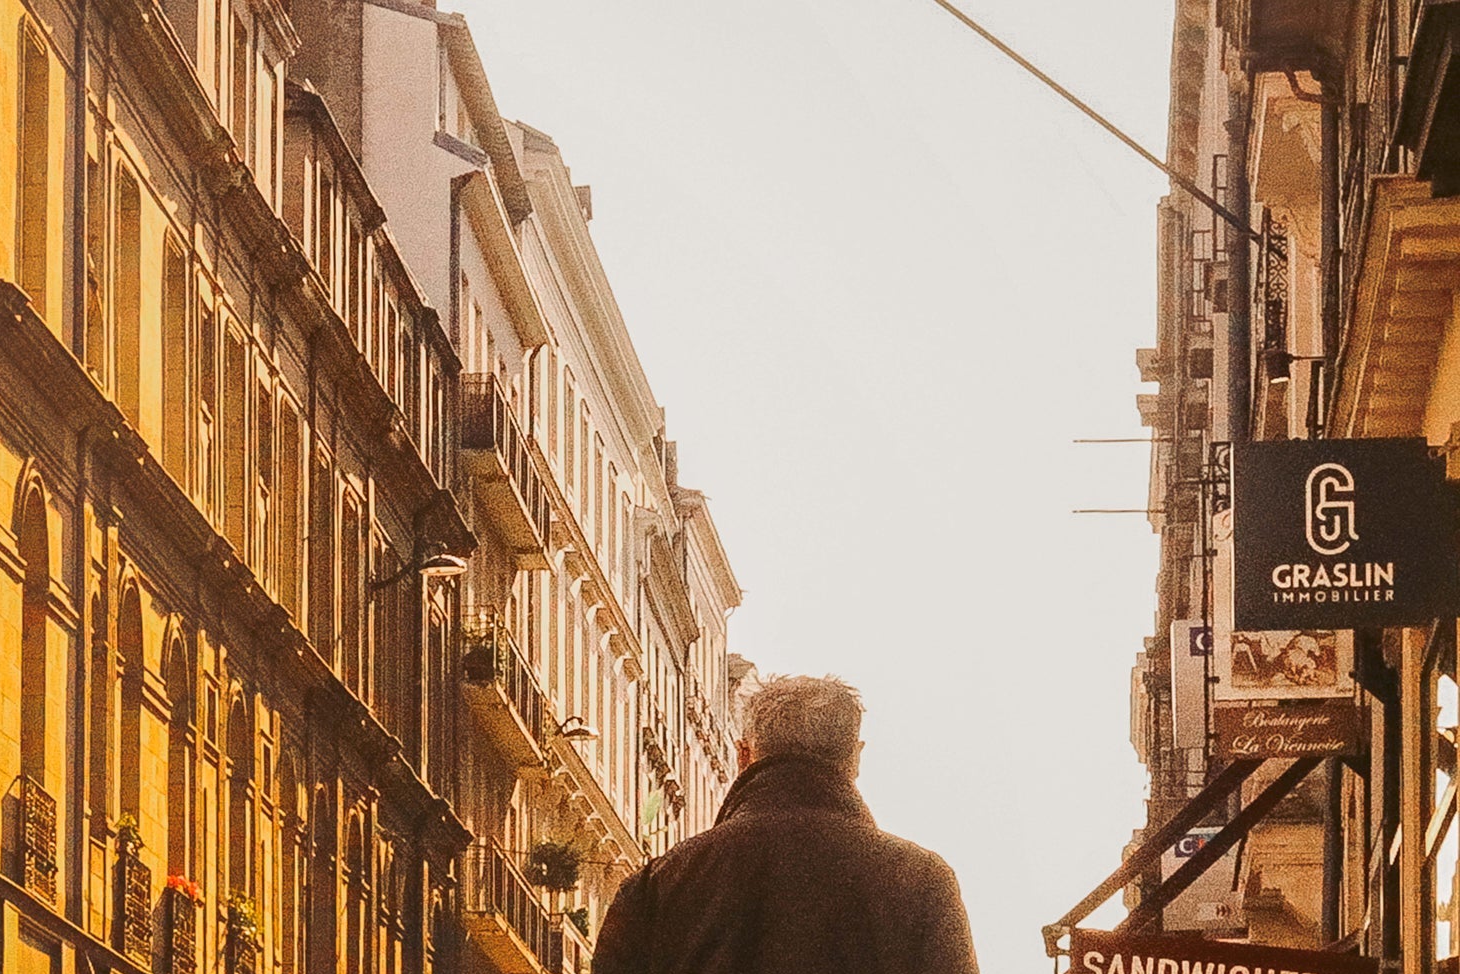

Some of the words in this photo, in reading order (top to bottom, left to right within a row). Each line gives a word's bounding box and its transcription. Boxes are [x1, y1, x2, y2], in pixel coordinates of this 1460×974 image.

[1271, 562, 1394, 589] GRASLIN
[1273, 590, 1395, 602] IMMOBILIER
[1232, 734, 1260, 754] La
